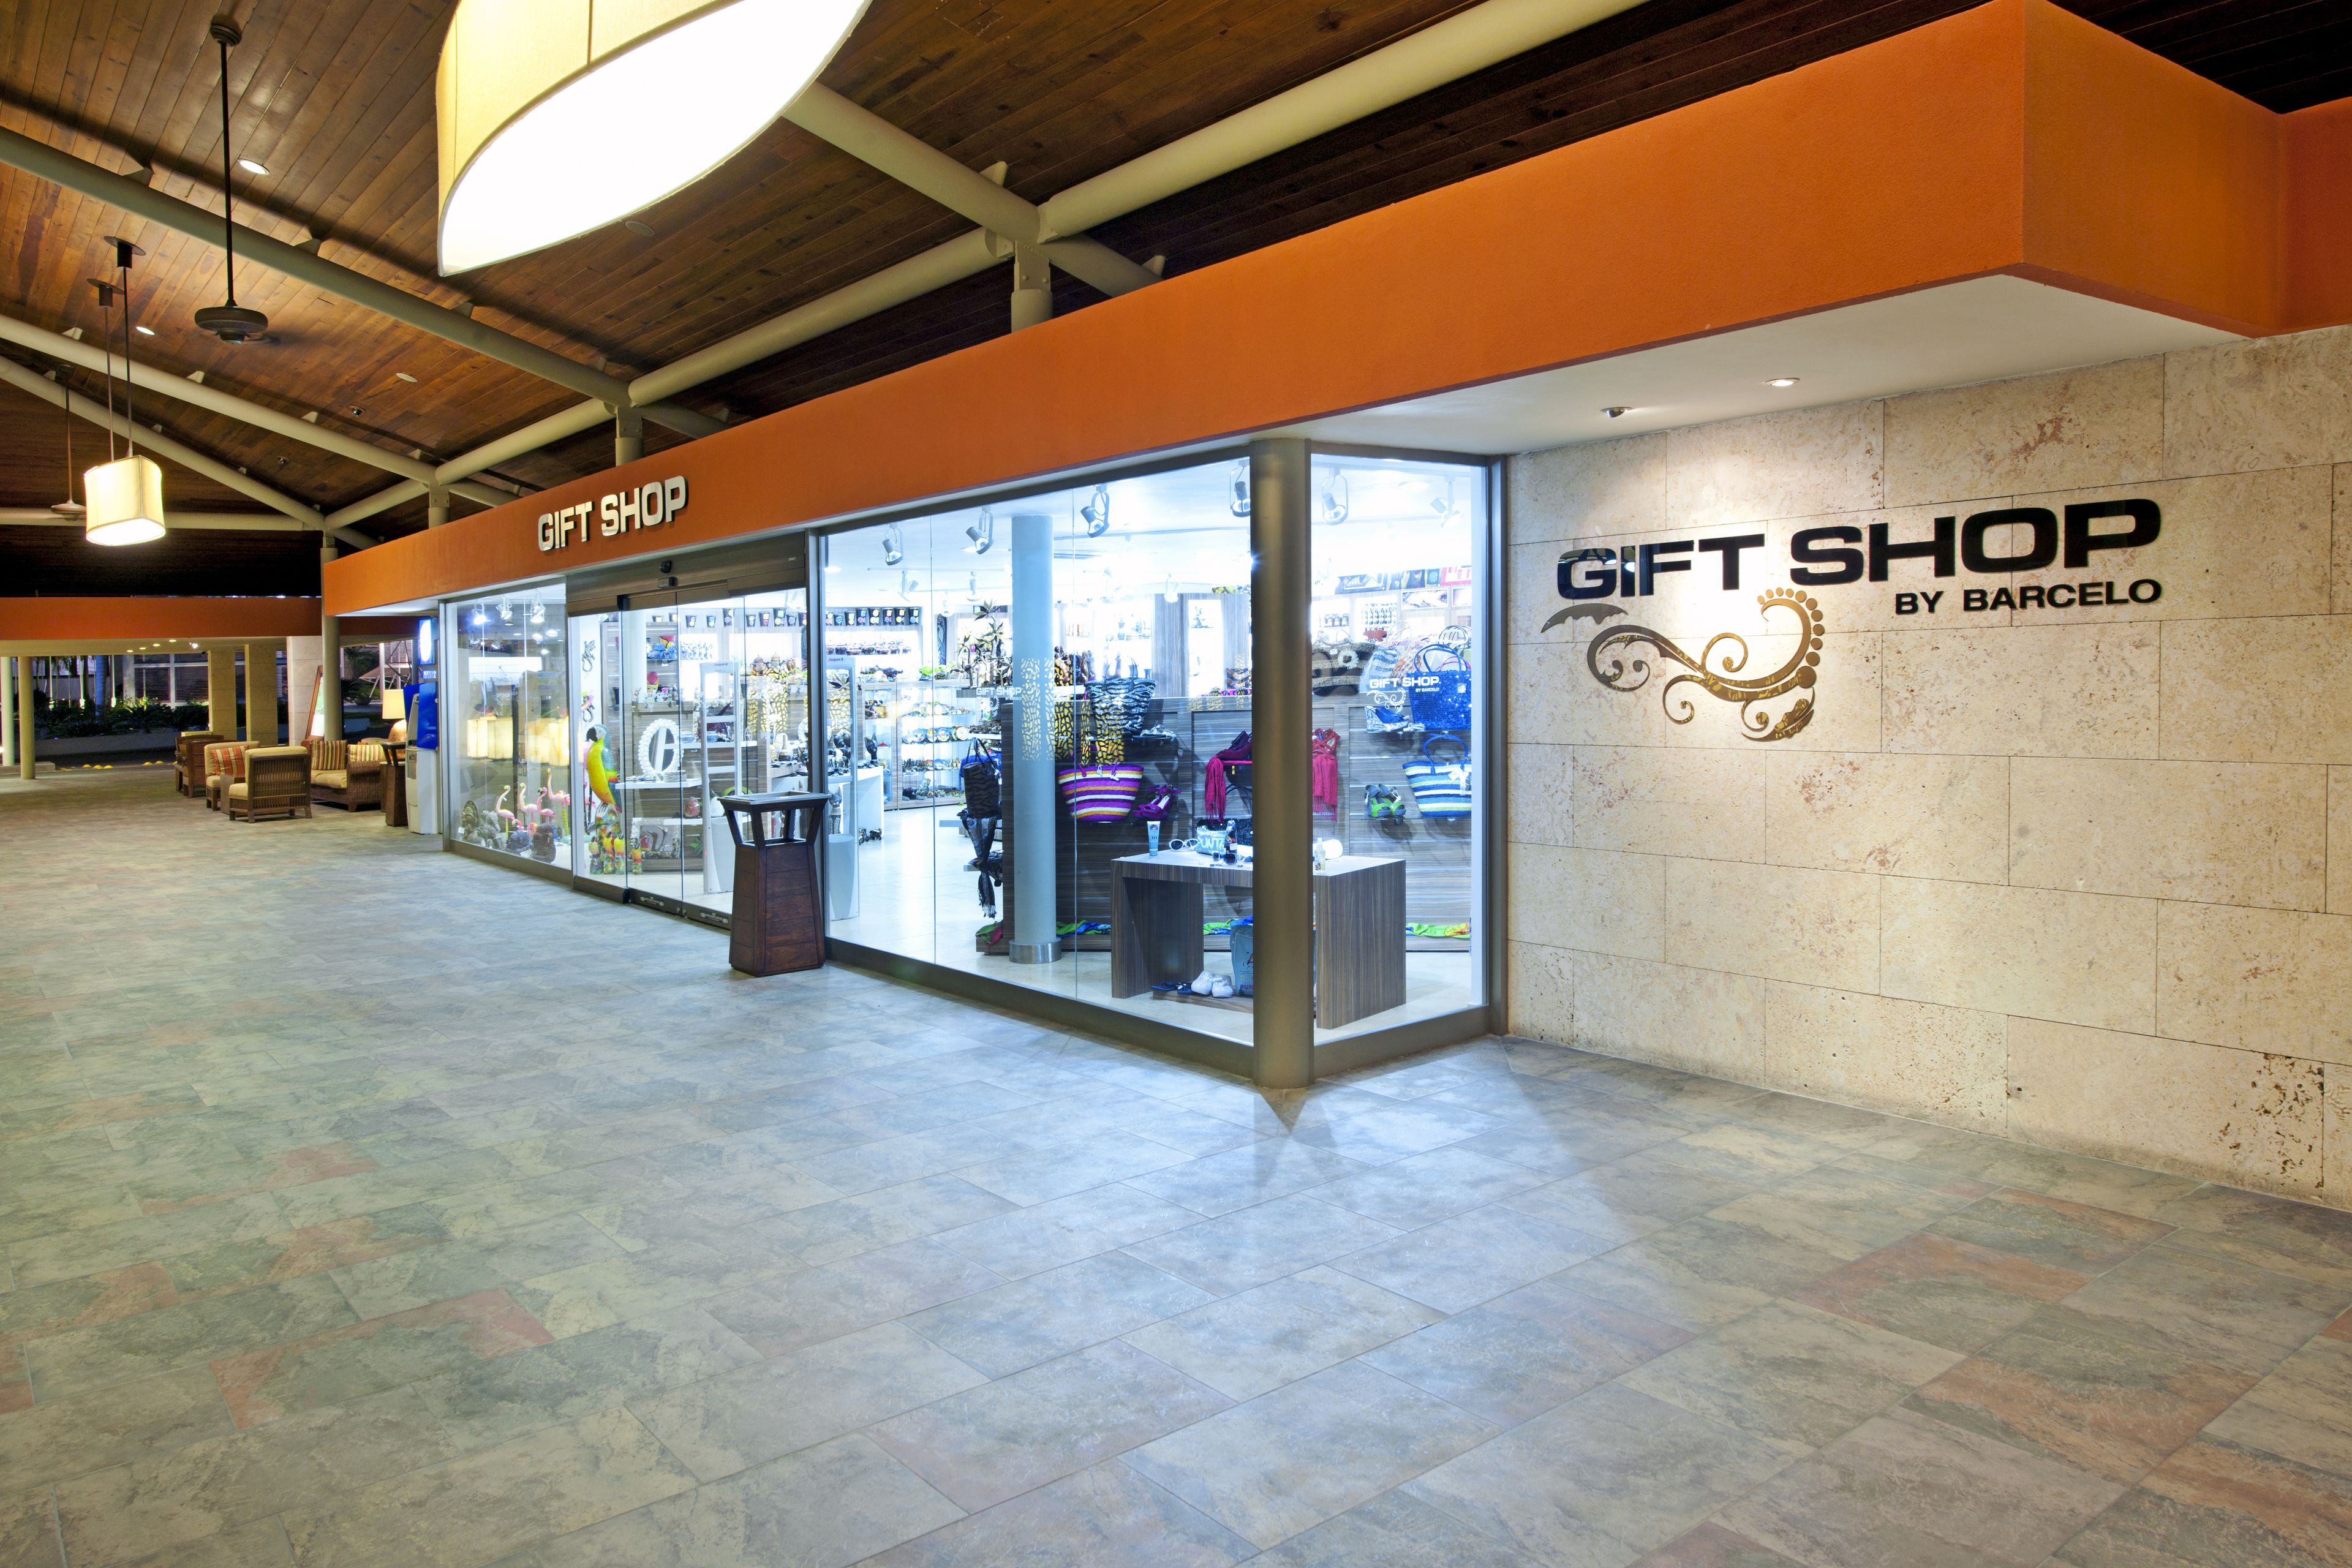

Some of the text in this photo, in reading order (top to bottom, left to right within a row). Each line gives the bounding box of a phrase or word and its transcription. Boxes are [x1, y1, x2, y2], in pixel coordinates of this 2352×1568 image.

[538, 475, 687, 551] GIFT SHOP
[1558, 498, 2162, 600] GIFT SHOP
[1895, 579, 2163, 616] BY BARCELO
[997, 687, 1021, 695] SHOP
[1370, 678, 1399, 688] GIFT
